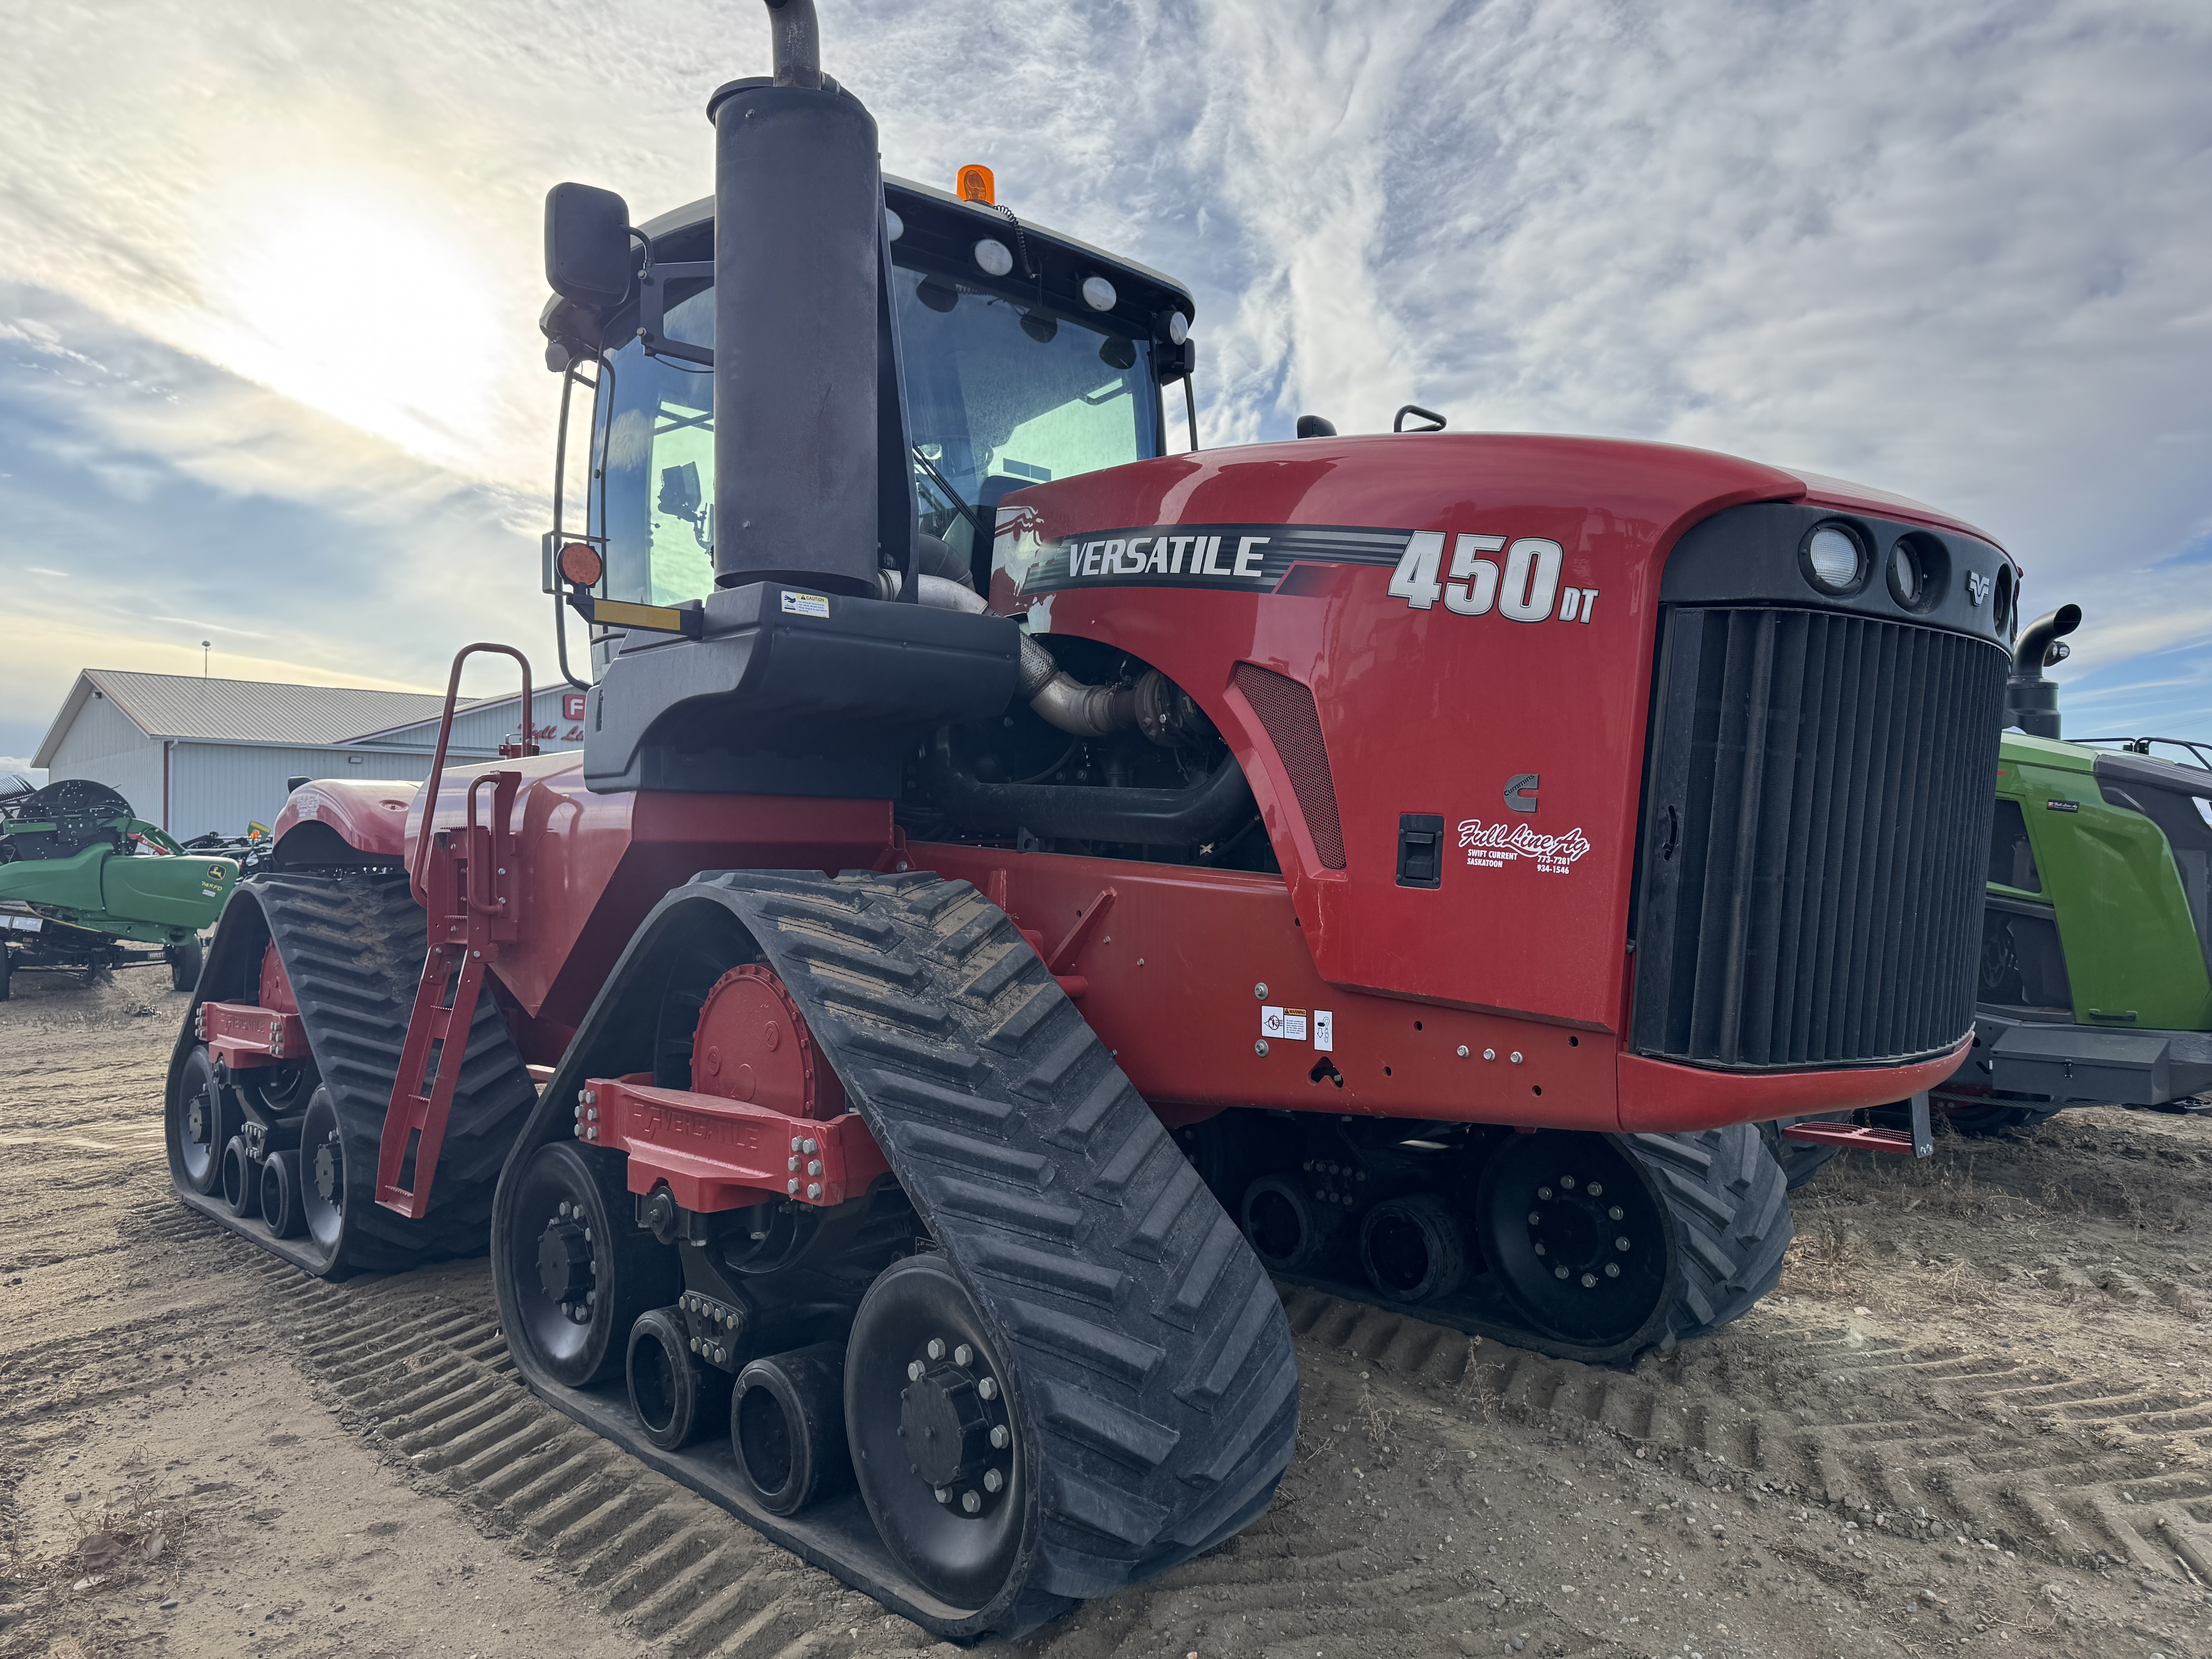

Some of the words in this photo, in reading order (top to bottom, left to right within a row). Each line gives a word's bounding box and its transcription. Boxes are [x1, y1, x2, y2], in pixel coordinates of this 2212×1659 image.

[1070, 536, 1271, 577] VERSATILE
[1387, 531, 1564, 623] 450
[1558, 586, 1600, 624] DT
[518, 722, 557, 739] ull
[1458, 819, 1508, 848] Full
[1502, 823, 1554, 857] Line
[1546, 828, 1590, 862] Ag
[1467, 857, 1503, 868] SASKATOON
[1468, 849, 1487, 857] SWIFT
[1489, 851, 1518, 860] CURRENT
[1537, 855, 1570, 865] 773-7281
[1537, 864, 1570, 874] 934-1546
[660, 1109, 758, 1150] VERSATILE
